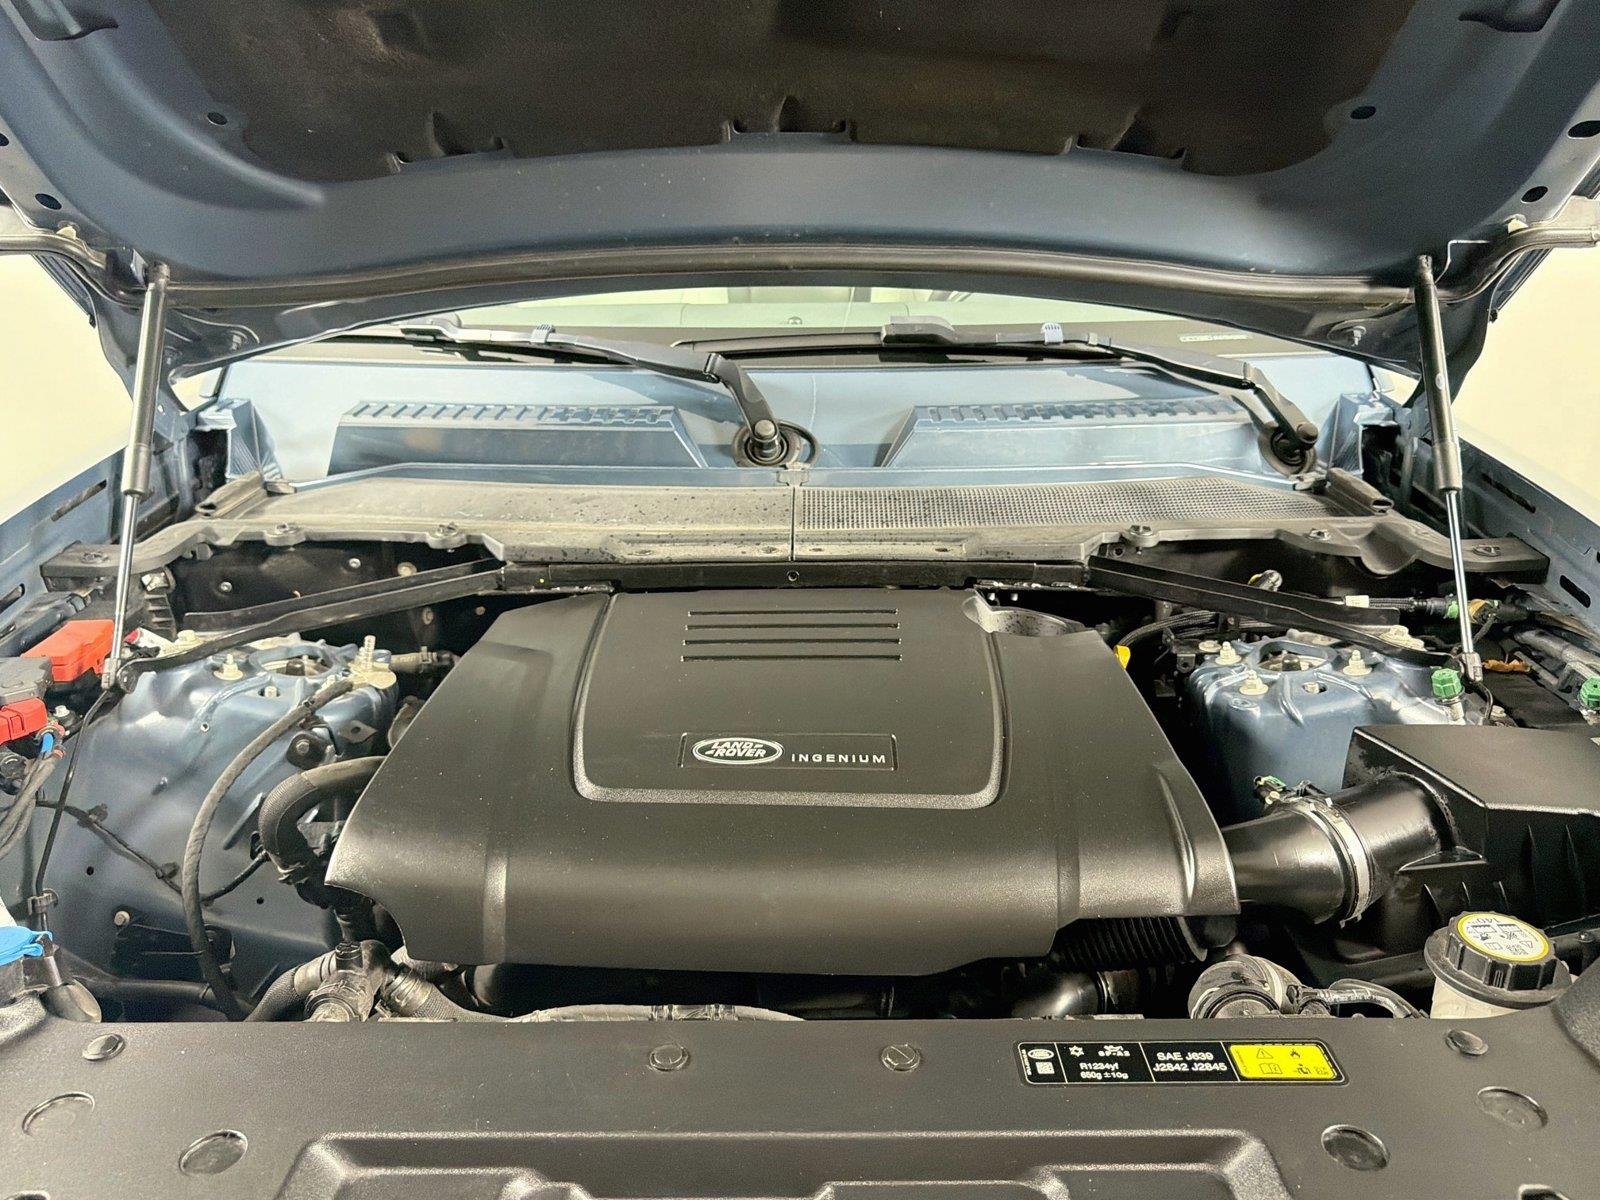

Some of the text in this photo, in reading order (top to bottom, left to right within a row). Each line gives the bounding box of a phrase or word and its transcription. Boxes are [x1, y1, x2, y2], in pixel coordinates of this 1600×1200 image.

[712, 741, 754, 750] LAND
[713, 749, 766, 758] ROVER
[791, 753, 886, 764] INGENIUM
[1156, 1051, 1214, 1061] SAE J639
[1152, 1062, 1189, 1072] J2842
[1191, 1062, 1228, 1072] J2845
